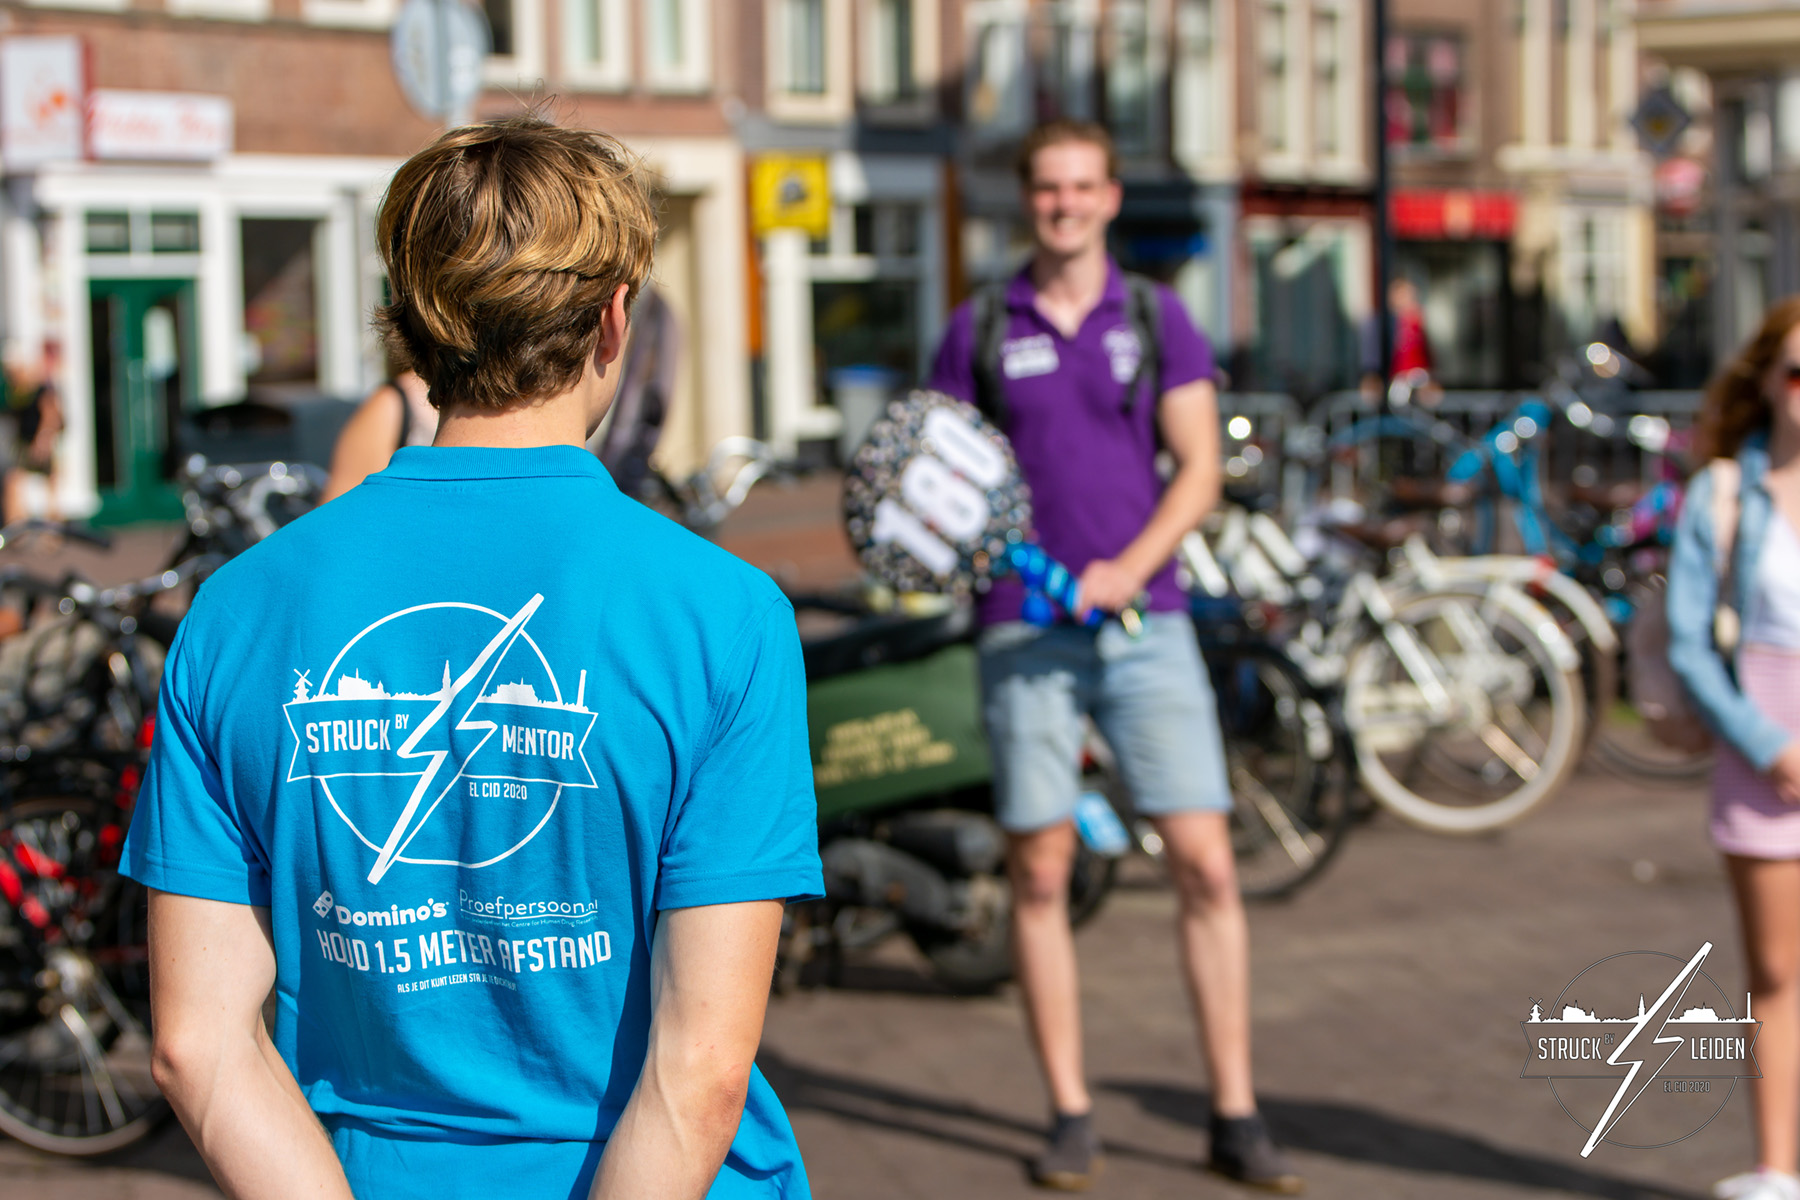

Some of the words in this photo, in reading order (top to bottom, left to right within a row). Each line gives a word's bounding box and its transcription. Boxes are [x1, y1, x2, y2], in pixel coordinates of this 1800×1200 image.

[870, 405, 1007, 577] 180
[306, 719, 391, 753] STRUCK
[395, 714, 409, 729] BY
[502, 725, 574, 760] MENTOR
[469, 782, 479, 798] EL
[482, 782, 500, 799] CID
[504, 783, 527, 800] 2020
[335, 898, 448, 926] Domino's
[460, 889, 598, 919] Proefpersoon.nl
[316, 929, 370, 971] HOUD
[375, 938, 411, 973] 1.5
[419, 930, 497, 969] METER
[498, 931, 611, 973] AFSTAND
[397, 983, 410, 993] ALS
[411, 982, 418, 991] JE
[419, 980, 430, 990] DIT
[431, 976, 448, 988] KUNT
[448, 973, 467, 984] LEZEN
[469, 973, 481, 982] STA
